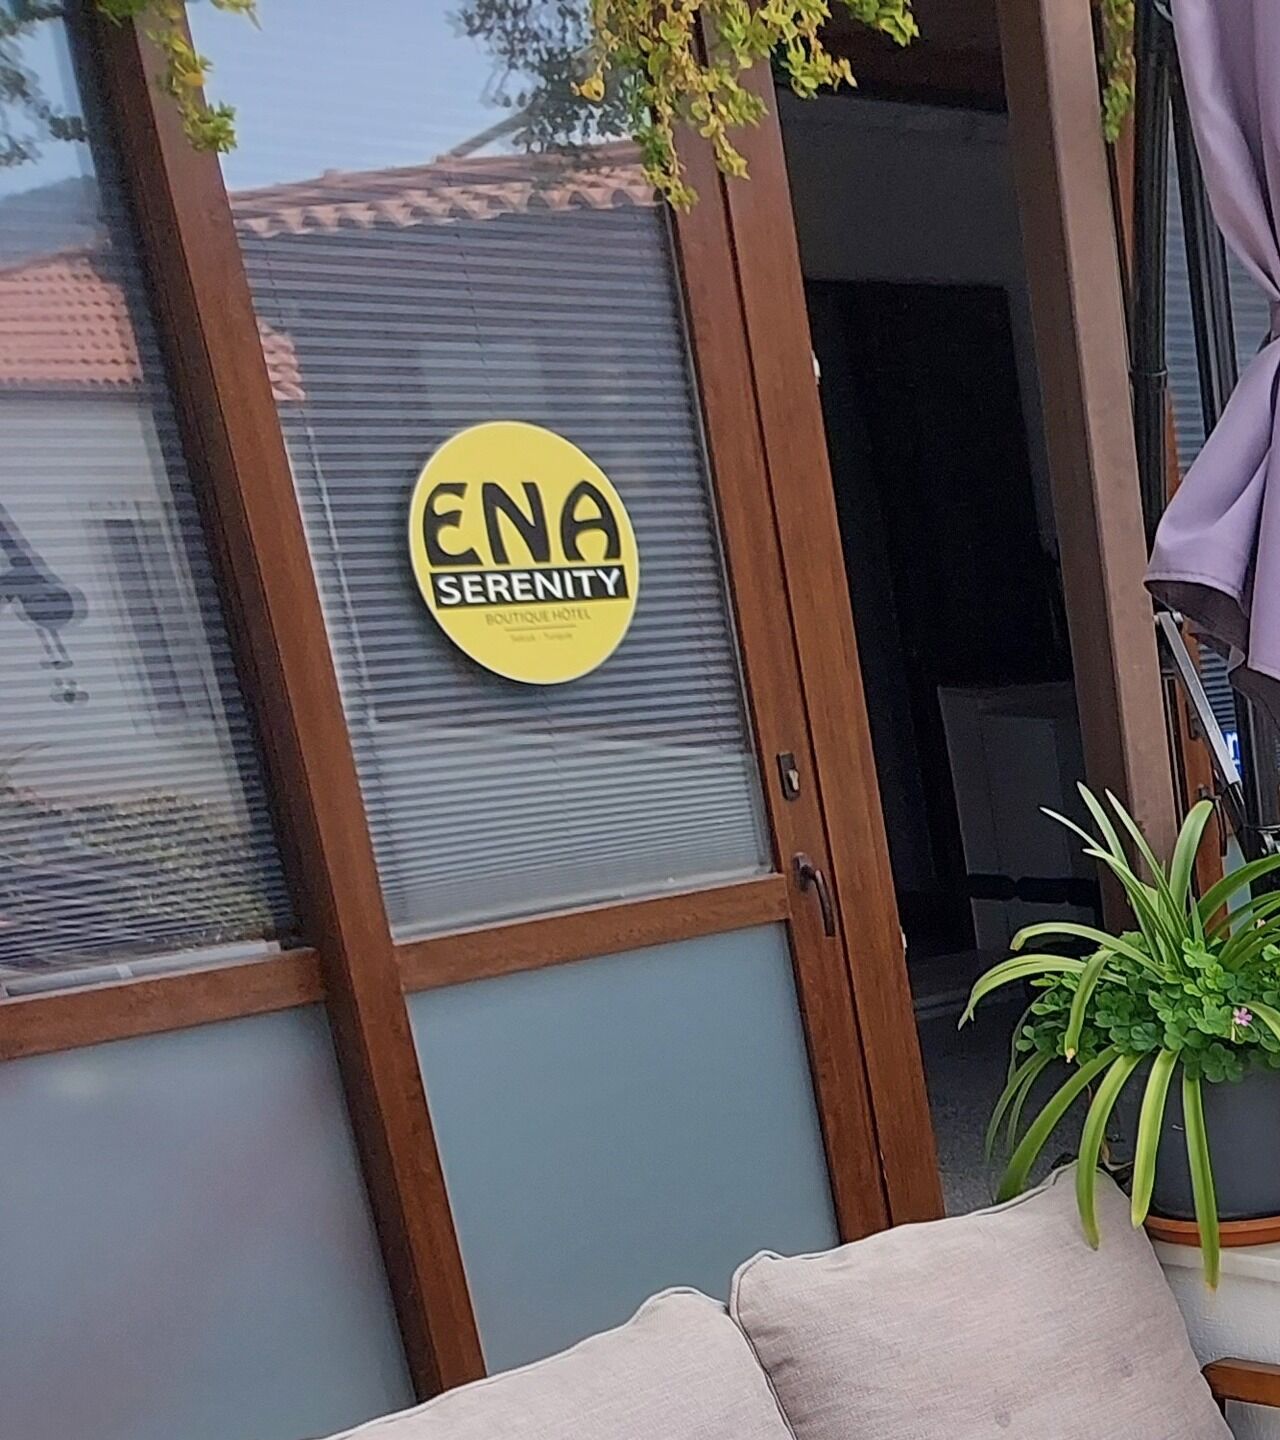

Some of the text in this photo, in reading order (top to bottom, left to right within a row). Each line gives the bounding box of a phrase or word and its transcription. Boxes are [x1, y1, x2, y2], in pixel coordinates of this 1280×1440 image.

[423, 480, 621, 567] ENA
[437, 568, 621, 606] SERENITY
[485, 609, 550, 626] BOUTIQUE
